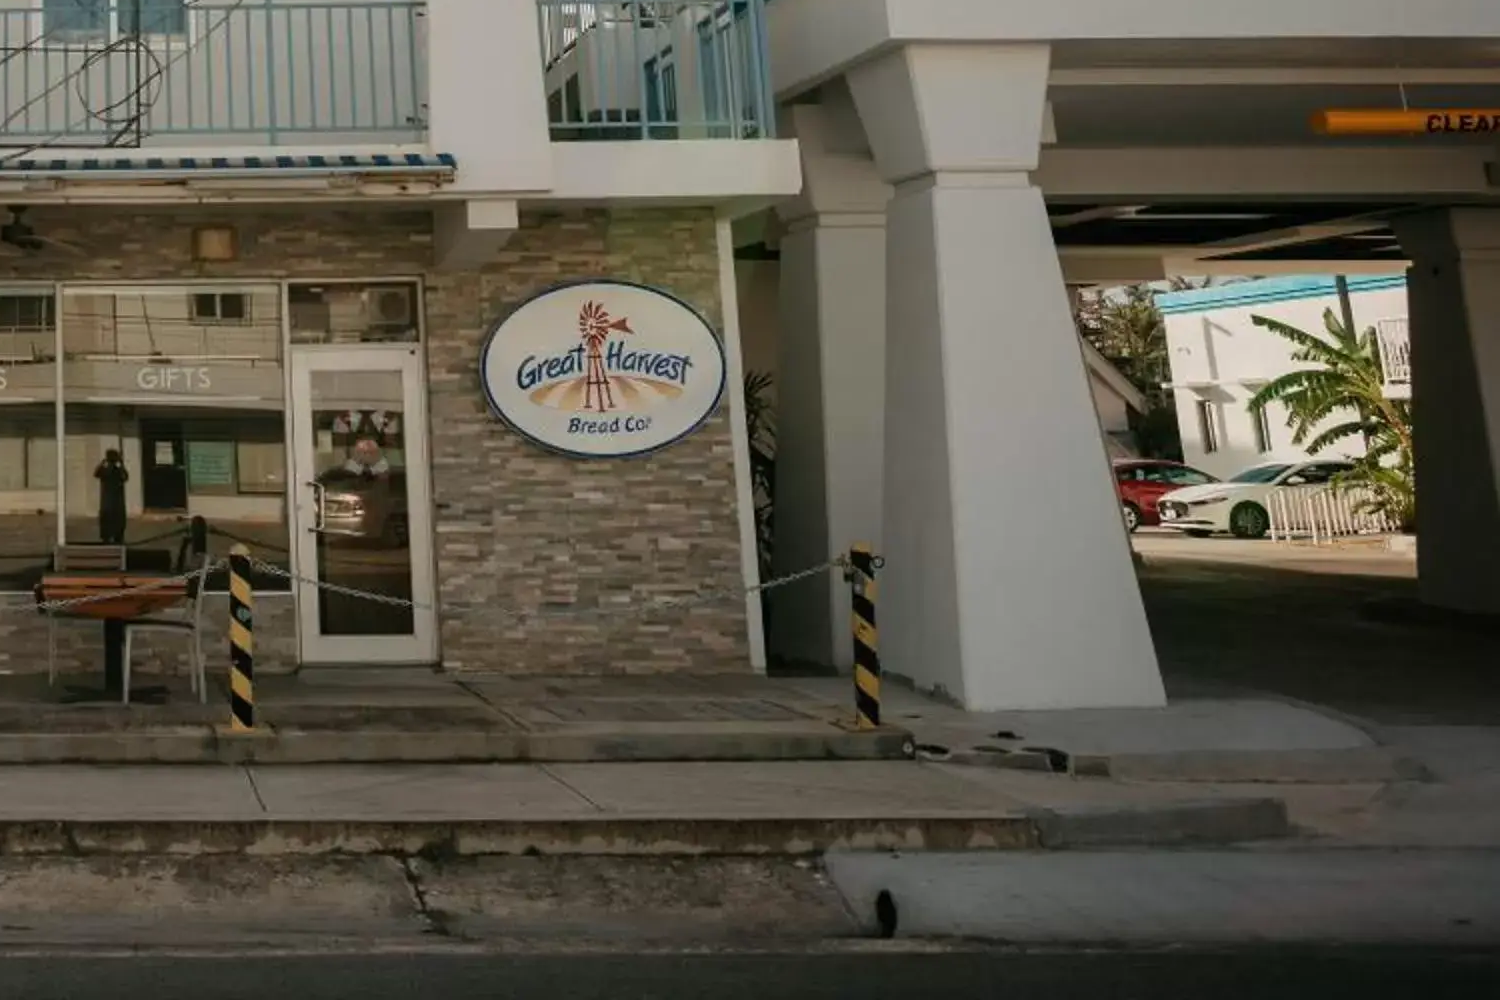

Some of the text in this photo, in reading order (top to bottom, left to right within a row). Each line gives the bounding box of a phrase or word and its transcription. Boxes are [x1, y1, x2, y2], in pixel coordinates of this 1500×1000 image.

[516, 341, 694, 390] Great Harvest
[136, 367, 212, 389] GIFTS
[566, 416, 620, 434] Bread
